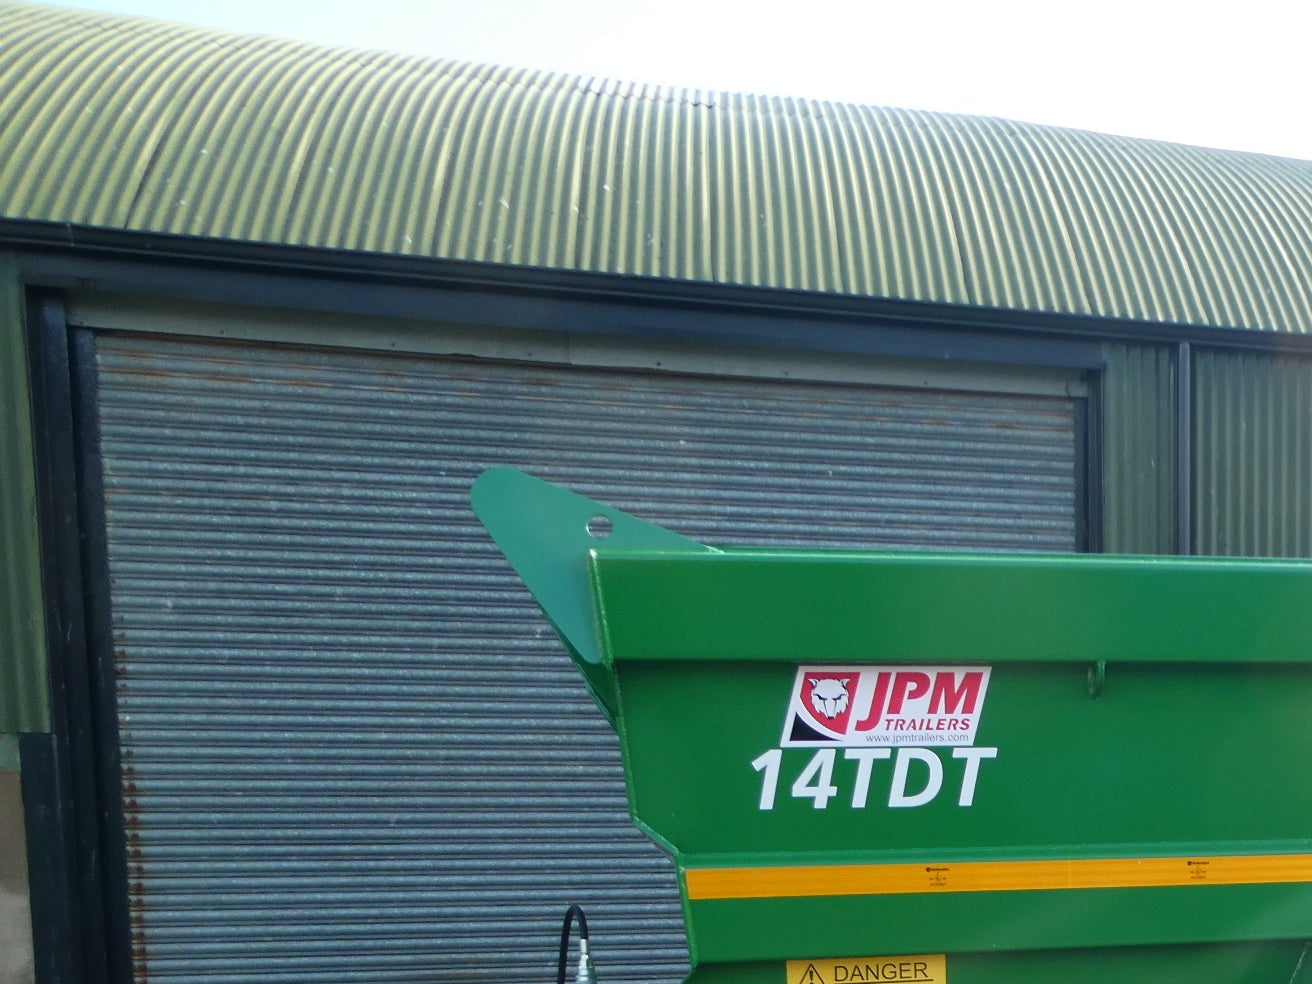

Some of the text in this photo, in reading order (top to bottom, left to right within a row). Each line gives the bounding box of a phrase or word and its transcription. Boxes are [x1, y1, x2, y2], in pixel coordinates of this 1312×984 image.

[855, 671, 984, 731] JPM
[885, 718, 971, 731] TRAILERS
[865, 732, 969, 744] www.jpmtrailers.com
[751, 747, 998, 810] 14TDT
[834, 962, 929, 982] DANGER
